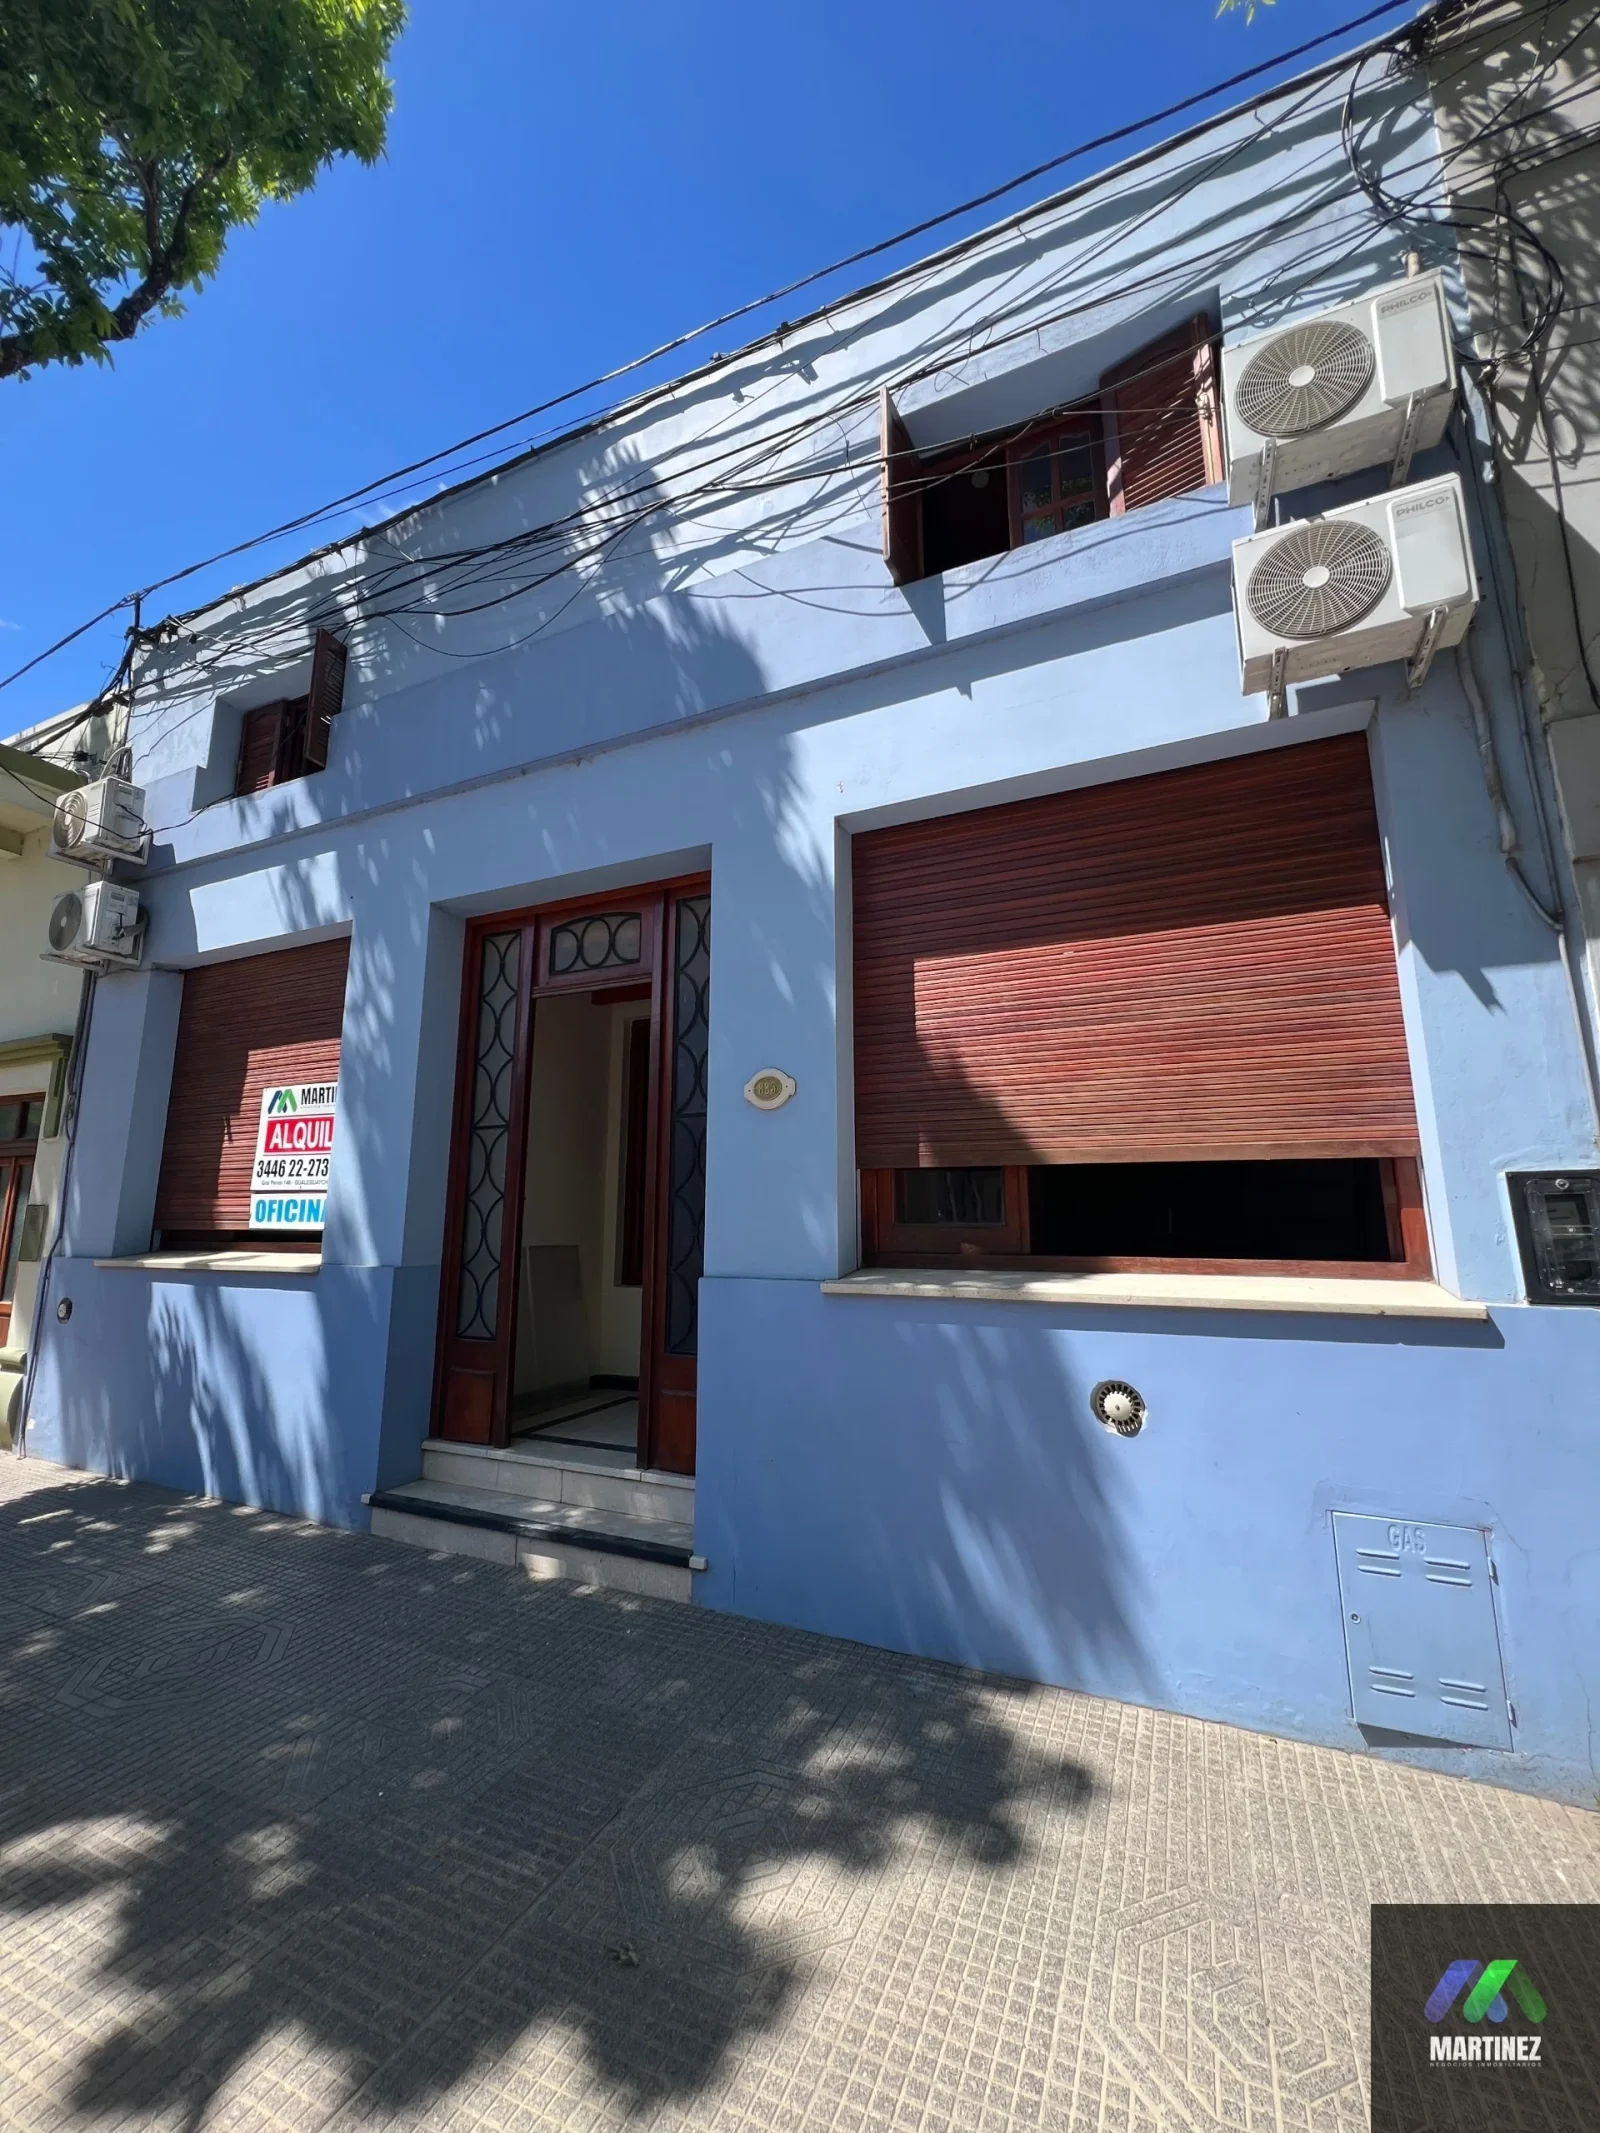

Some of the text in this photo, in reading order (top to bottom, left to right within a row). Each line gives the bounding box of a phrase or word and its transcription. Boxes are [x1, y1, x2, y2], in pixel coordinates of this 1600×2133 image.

[1381, 292, 1428, 313] PHILCO
[1396, 496, 1445, 517] PHILCO
[301, 1086, 337, 1105] MARTI
[269, 1120, 332, 1150] ALQUIL
[257, 1158, 329, 1178] 3446 22-273
[1387, 1523, 1427, 1555] GAS
